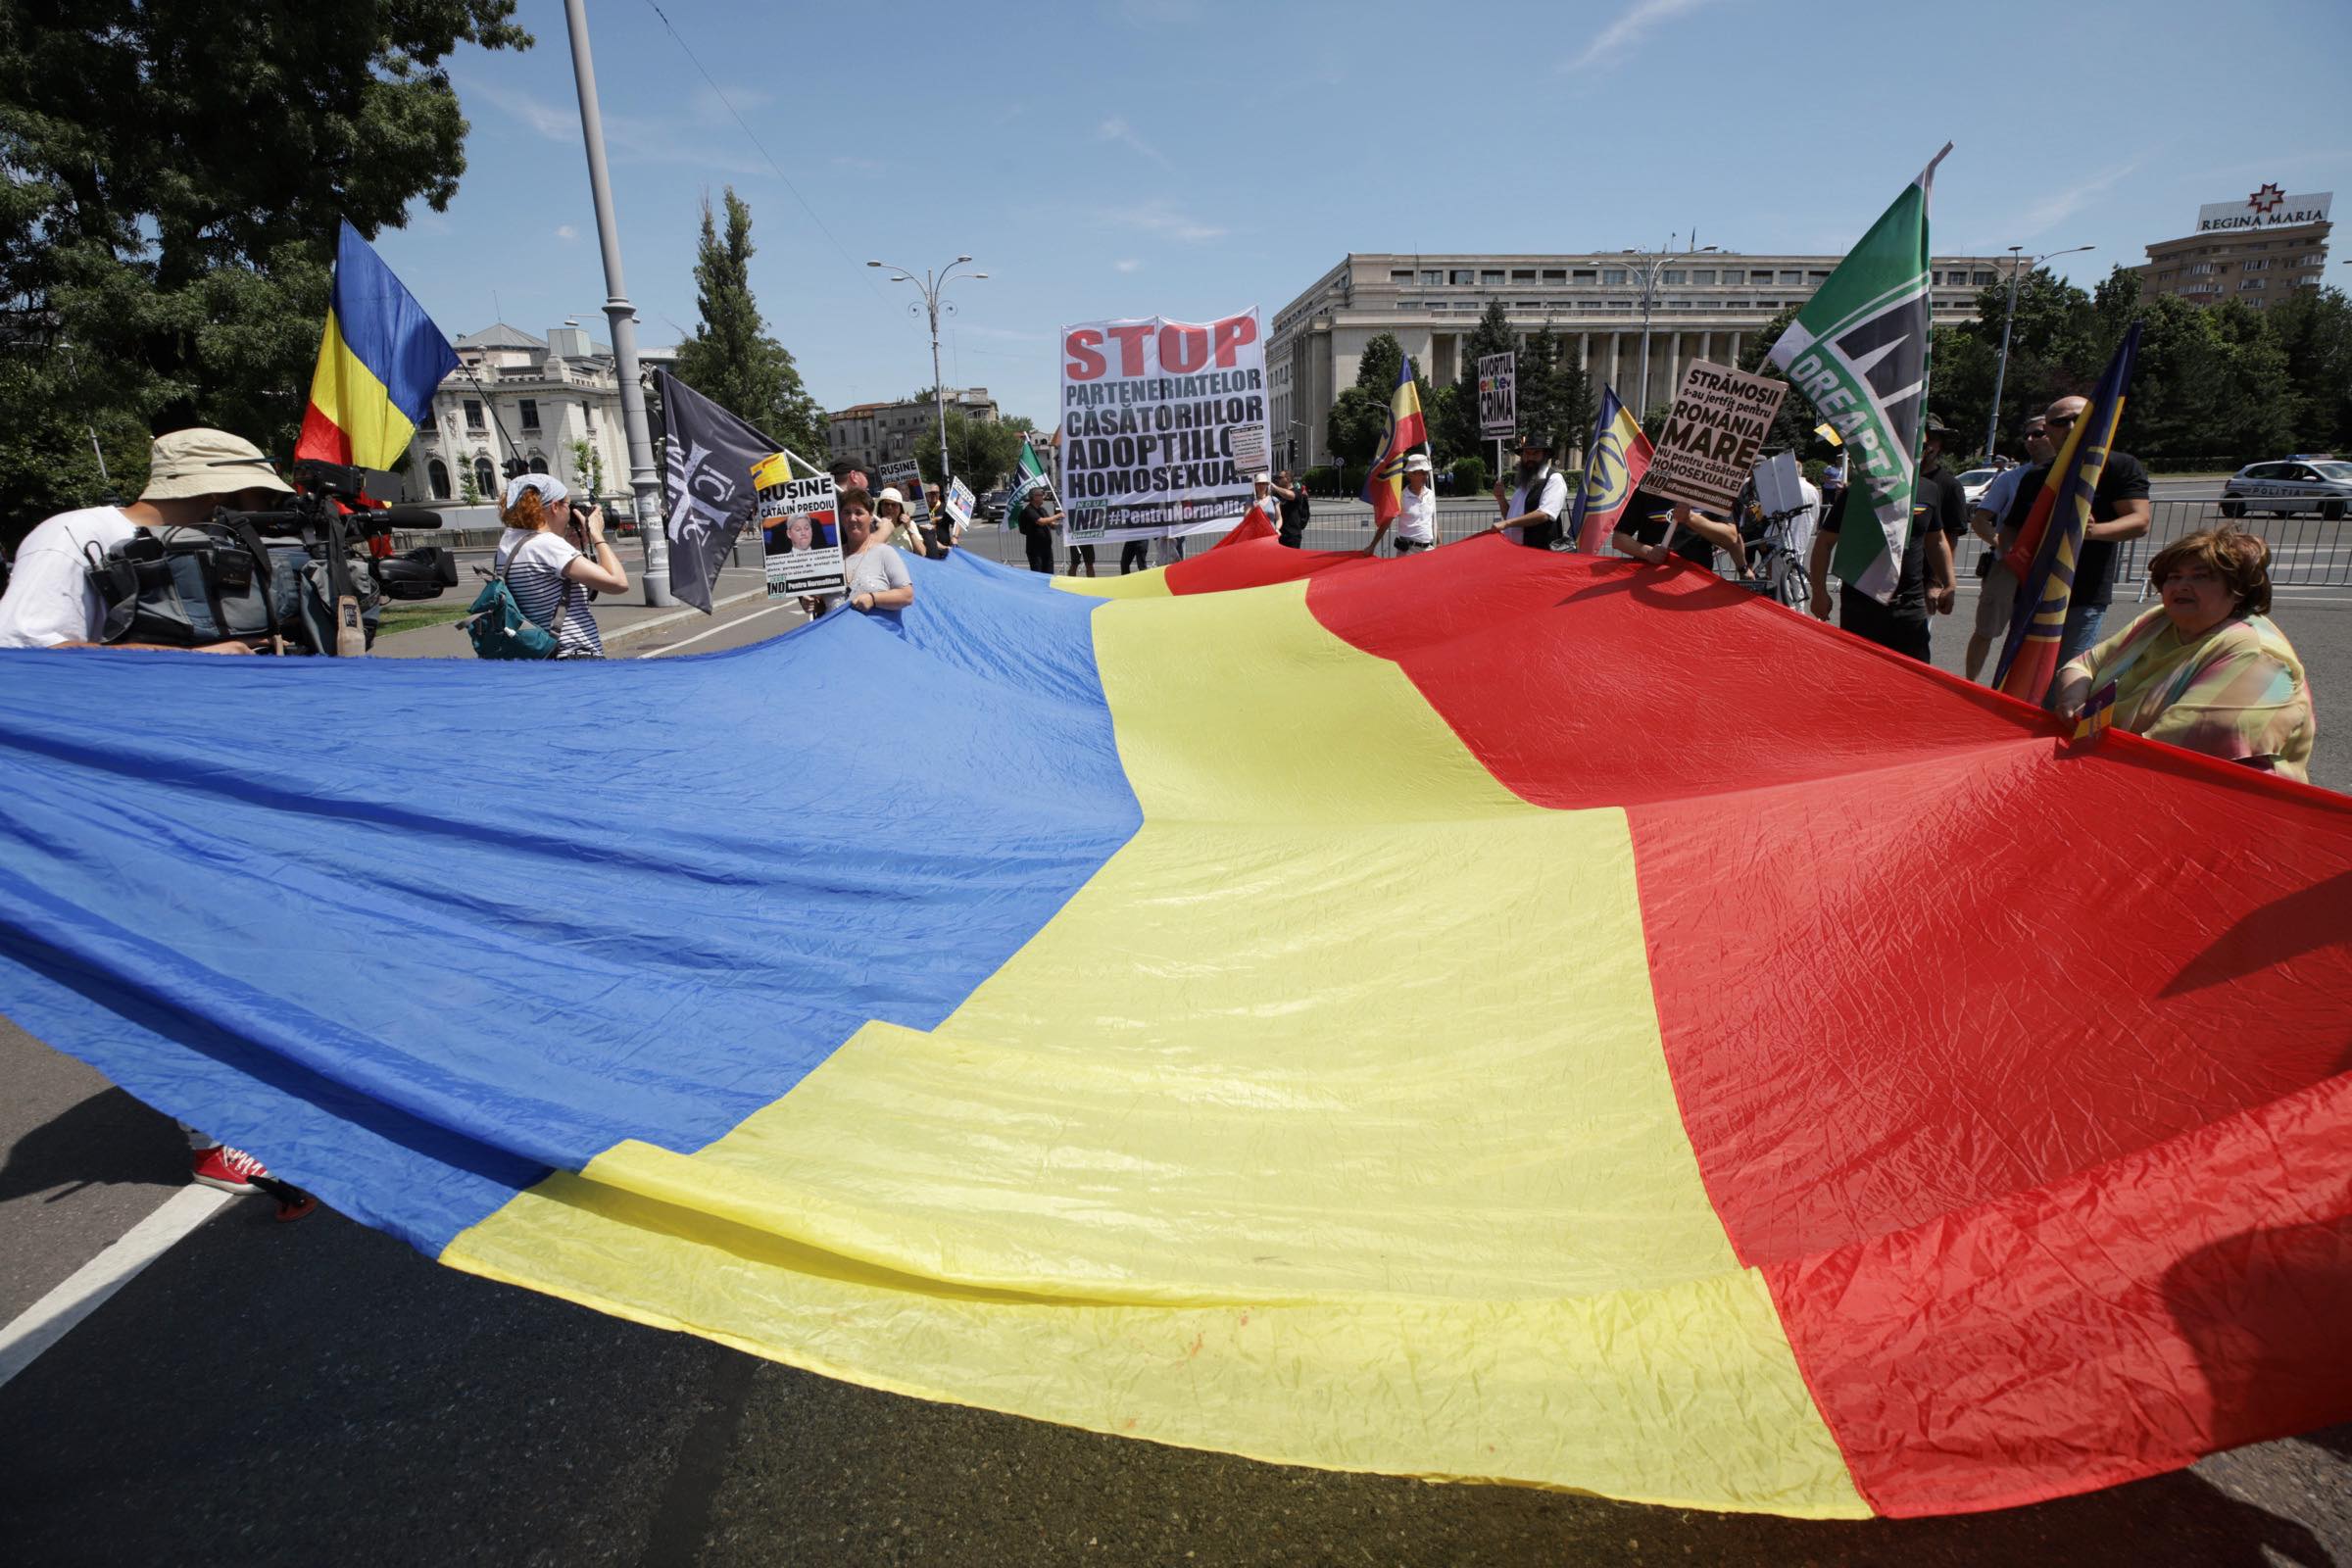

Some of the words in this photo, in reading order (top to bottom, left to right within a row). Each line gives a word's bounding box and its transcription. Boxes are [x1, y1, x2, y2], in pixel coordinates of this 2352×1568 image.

[2201, 216, 2262, 231] REGINA
[2268, 210, 2323, 225] MARIA
[1065, 316, 1257, 381] STOP
[1480, 354, 1514, 378] AVORTUL
[1066, 368, 1261, 407] PARTENERIATELOR
[1683, 388, 1703, 401] s-au
[1735, 403, 1772, 418] pentru
[1066, 395, 1263, 437] CĂSĂTORIILOR
[1673, 399, 1765, 440] ROMÂNIA
[1656, 446, 1672, 458] NU
[1671, 451, 1703, 468] pentru
[1660, 418, 1761, 470] MARE
[1651, 458, 1743, 492] HOMOSEXUALE!
[797, 500, 835, 513] PREDOIU
